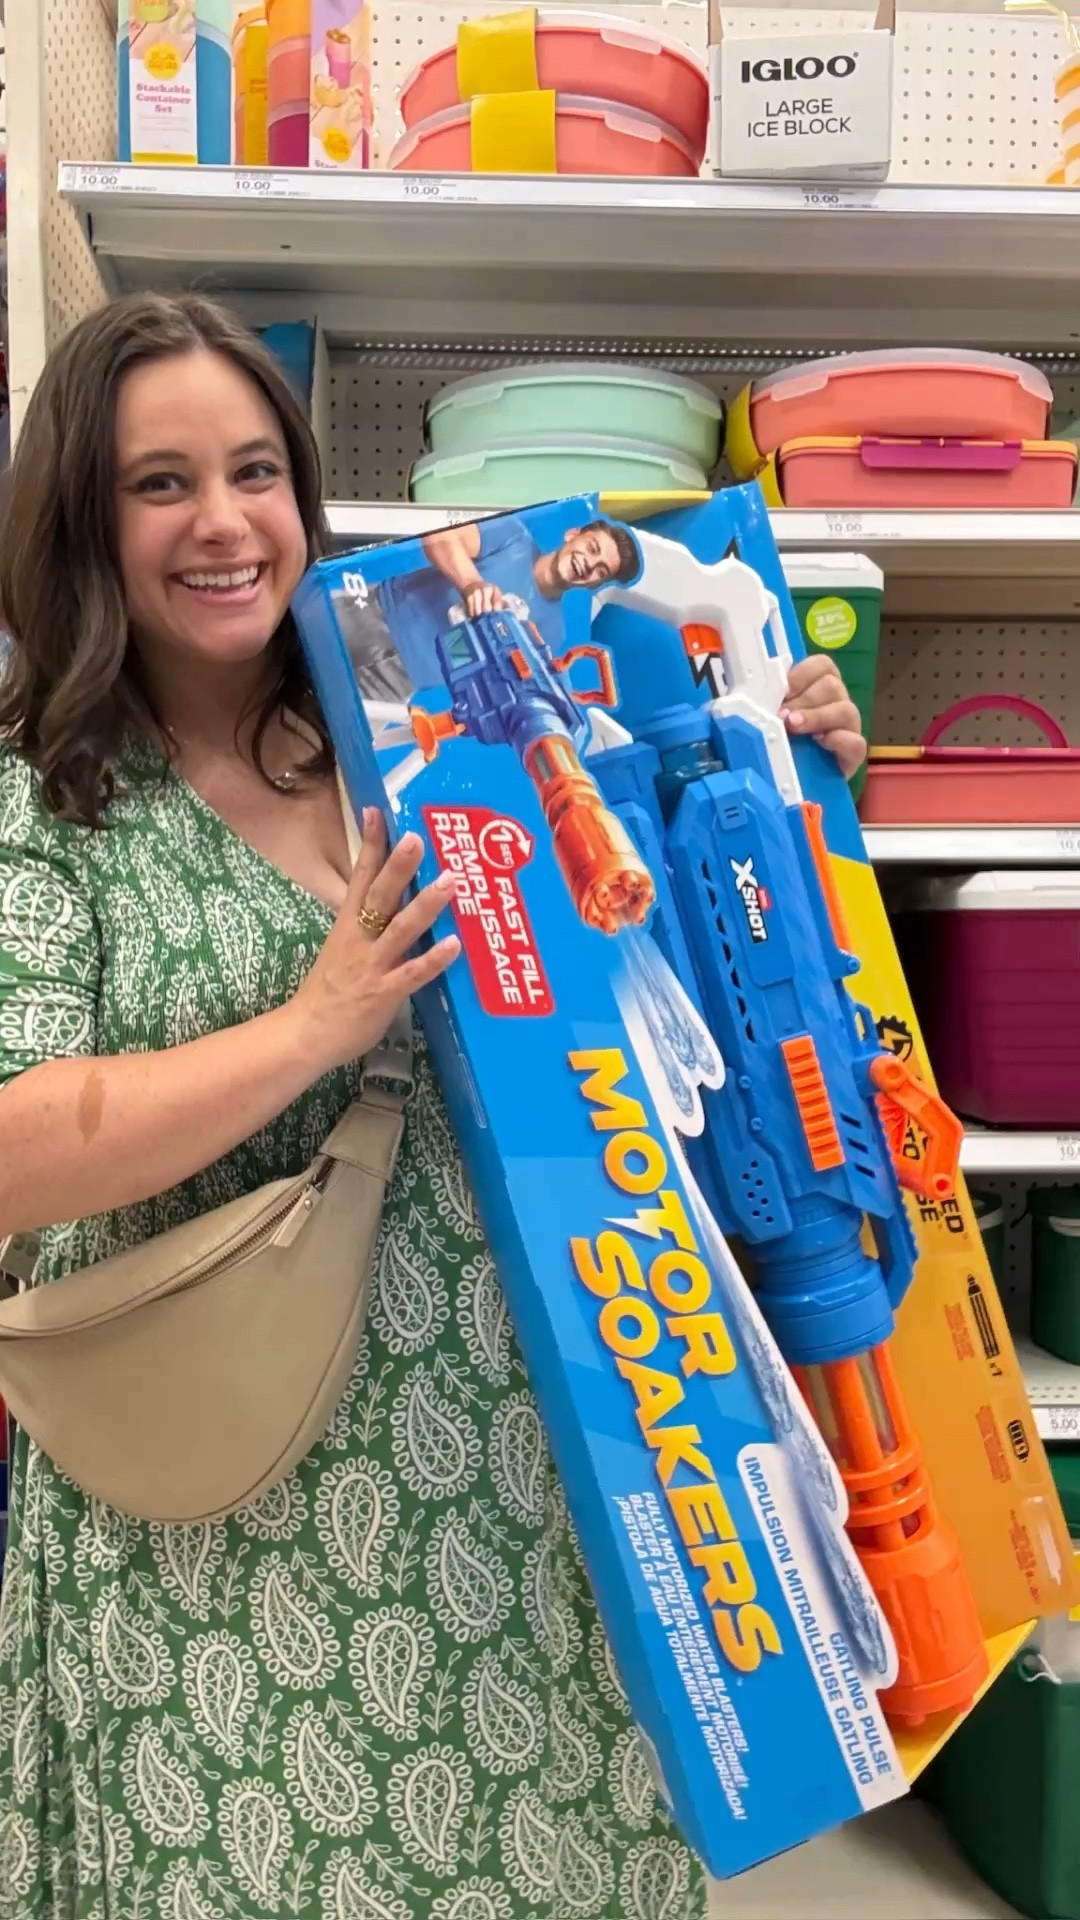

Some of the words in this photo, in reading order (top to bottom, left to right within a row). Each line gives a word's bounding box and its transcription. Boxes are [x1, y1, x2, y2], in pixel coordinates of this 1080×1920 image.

[741, 55, 857, 83] IGLOO
[136, 83, 191, 94] Stackable
[136, 93, 191, 104] Container
[155, 104, 173, 113] Set
[766, 98, 833, 117] LARGE
[748, 122, 779, 138] ICE
[784, 117, 851, 136] BLOCK
[80, 175, 118, 186] 10.00
[234, 180, 271, 191] 10.00
[403, 186, 440, 196] 10.00
[803, 194, 840, 204] 10.00
[490, 827, 514, 847] 1
[431, 811, 478, 917] RAPIDE
[499, 843, 515, 866] SEC
[450, 812, 525, 1005] REMPLISSAGE
[494, 876, 530, 947] FAST
[517, 952, 545, 1005] FILL
[567, 1048, 738, 1379] MOTOR
[1050, 1418, 1078, 1430] 5.00
[569, 1230, 784, 1672] SOAKERS
[628, 1493, 663, 1558] BLASTER
[658, 1575, 682, 1607] EAU
[639, 1564, 659, 1584] DE
[648, 1586, 675, 1629] AGUA
[641, 1491, 669, 1535] FULLY
[659, 1536, 701, 1621] MOTORIZED
[690, 1623, 720, 1676] WATER
[710, 1677, 750, 1753] BLASTERS!
[743, 1456, 794, 1565] IMPULSION
[784, 1567, 843, 1703] MITRAILLEUSE
[834, 1705, 874, 1786] GATLING
[665, 1630, 711, 1723] TOTALMENTE
[829, 1630, 868, 1712] GATLING
[859, 1715, 893, 1777] PULSE
[700, 1724, 748, 1821] MOTORIZADA!
